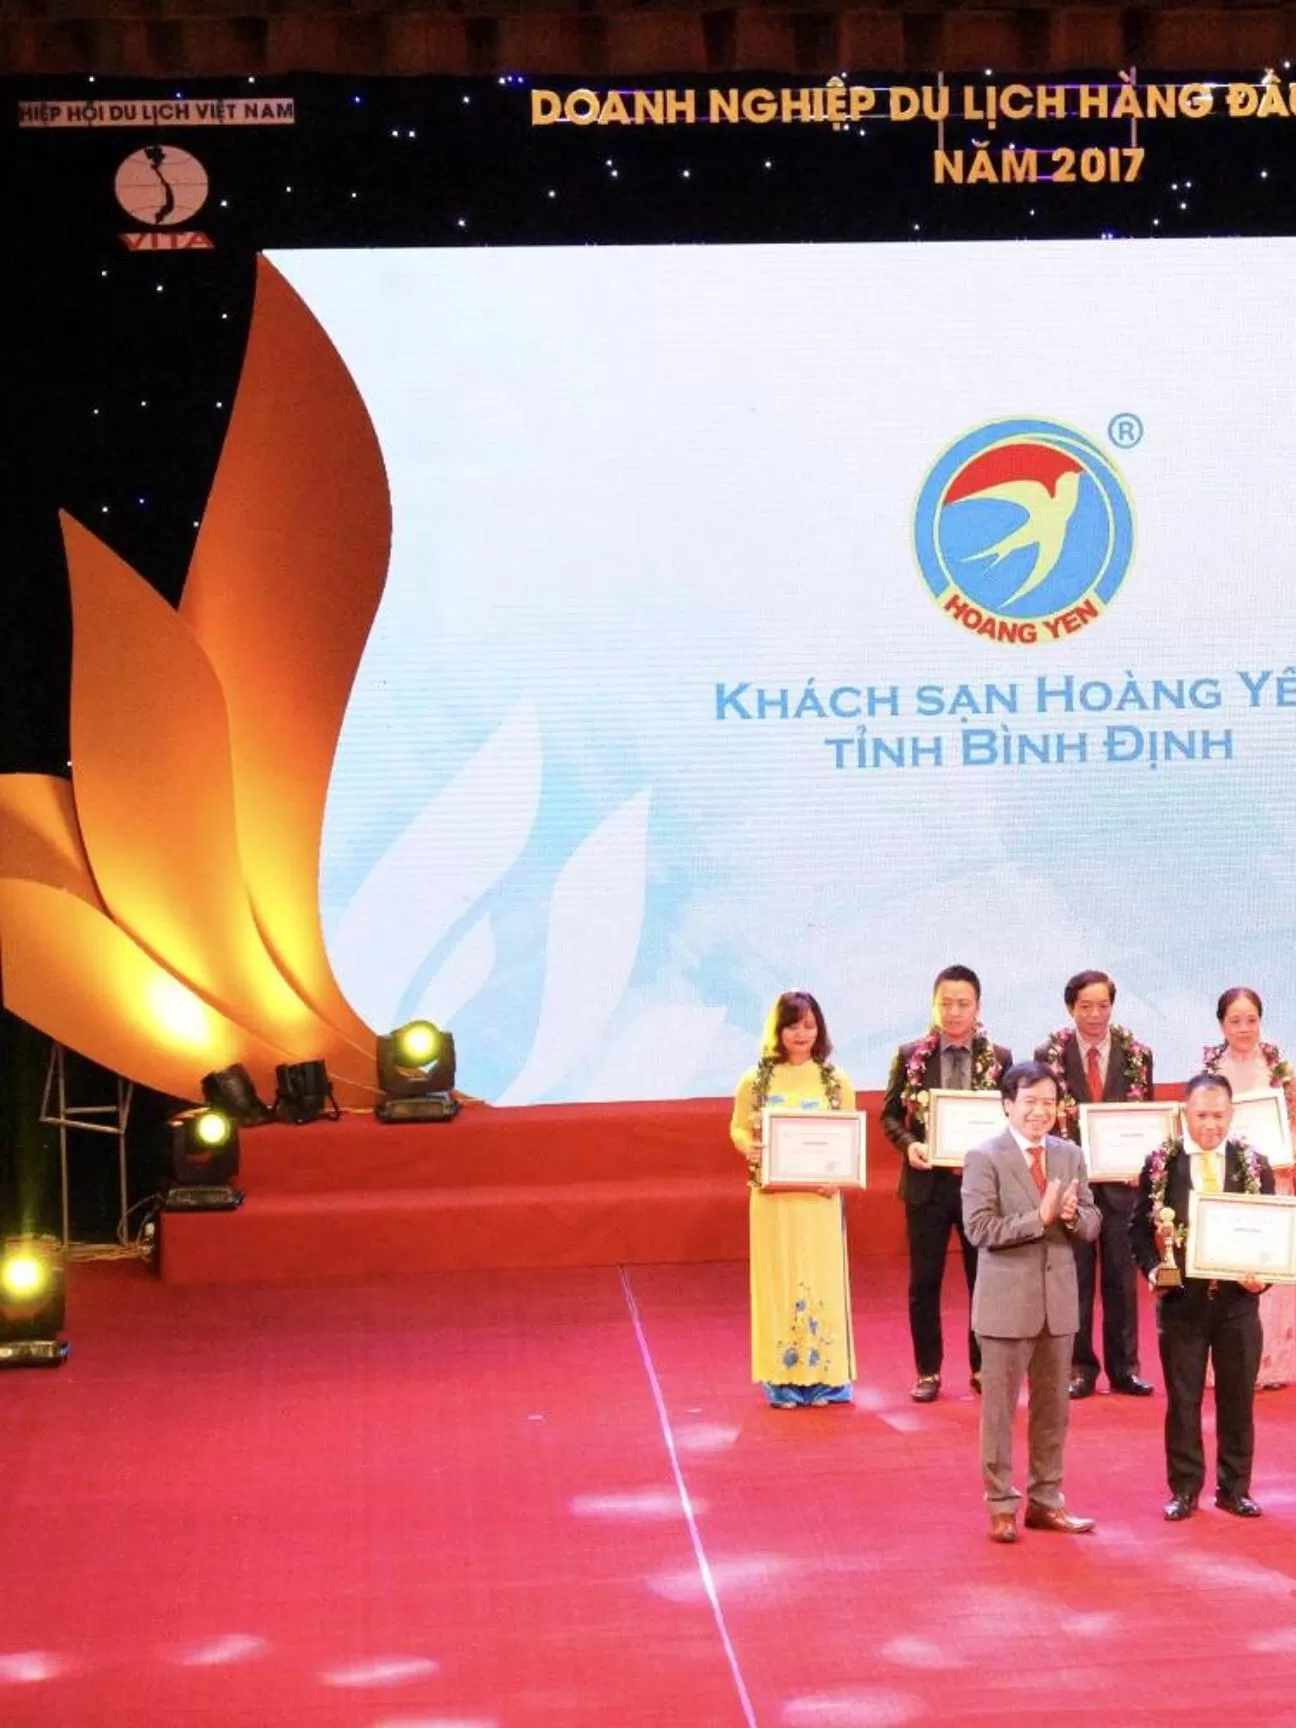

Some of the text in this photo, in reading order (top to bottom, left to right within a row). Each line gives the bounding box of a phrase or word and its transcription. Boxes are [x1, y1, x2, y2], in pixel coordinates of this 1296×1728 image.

[110, 104, 137, 121] DU
[143, 103, 189, 124] LỊCH
[244, 103, 293, 118] NAM
[531, 88, 696, 126] DOANH
[709, 76, 876, 130] NGHIỆP
[889, 86, 956, 121] DU
[964, 84, 1066, 129] LỊCH
[1079, 70, 1214, 118] HÀNG
[934, 138, 1145, 183] NĂM 2017
[944, 594, 1099, 644] HOANG YEN
